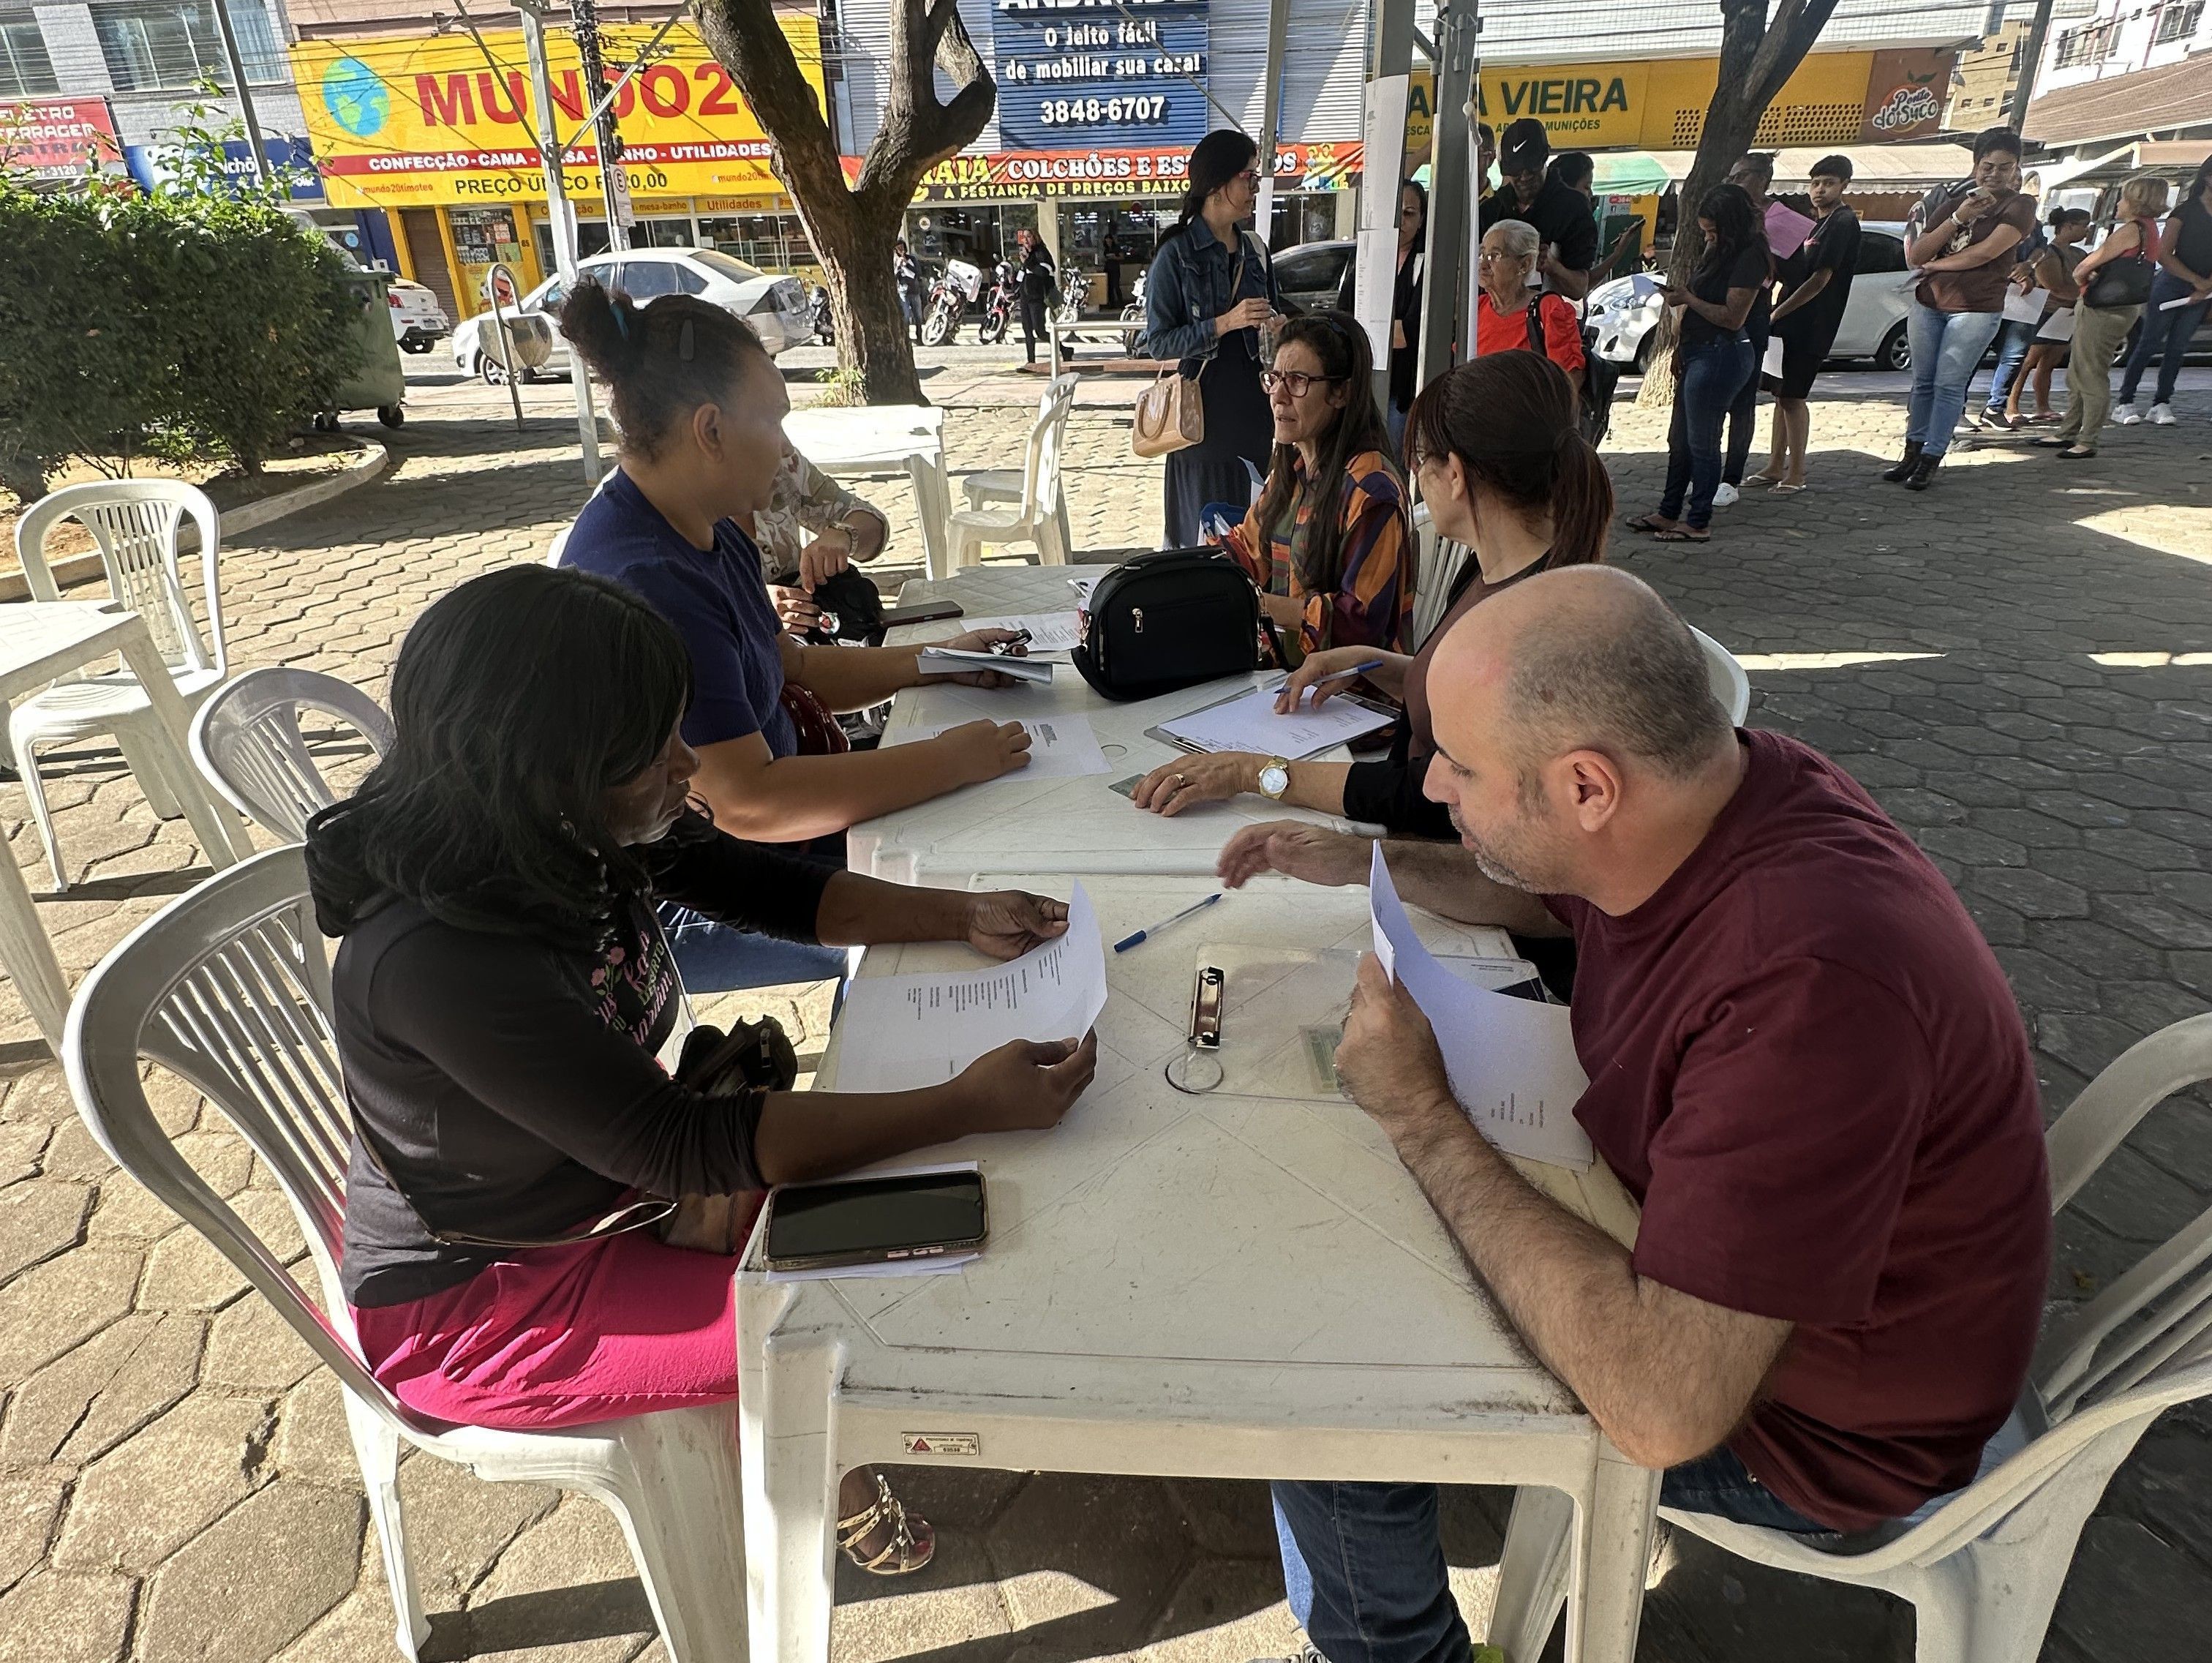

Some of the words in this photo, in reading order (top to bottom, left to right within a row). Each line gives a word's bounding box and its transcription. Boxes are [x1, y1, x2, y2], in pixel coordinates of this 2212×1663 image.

[1066, 24, 1109, 45] jeito
[1118, 20, 1156, 43] fácil
[1006, 59, 1026, 80] de
[1036, 56, 1108, 78] mobiliar
[1116, 59, 1146, 75] sua
[1500, 78, 1628, 115] VIEIRA
[1040, 96, 1165, 124] 3848-6707
[1546, 118, 1600, 132] MUNIÇÕES
[369, 153, 469, 171] CONFECÇÃO
[478, 153, 527, 165] CAMA
[671, 143, 772, 159] UTILIDADES
[1007, 153, 1130, 180] COLCHÕES
[1136, 156, 1152, 176] E
[455, 178, 522, 196] PREÇO
[944, 187, 955, 199] A
[960, 184, 1040, 198] FESTANÇA
[1047, 184, 1066, 195] DE
[1072, 182, 1135, 195] PREÇOS
[1142, 180, 1191, 193] BAIXO
[707, 198, 762, 210] Utilidades
